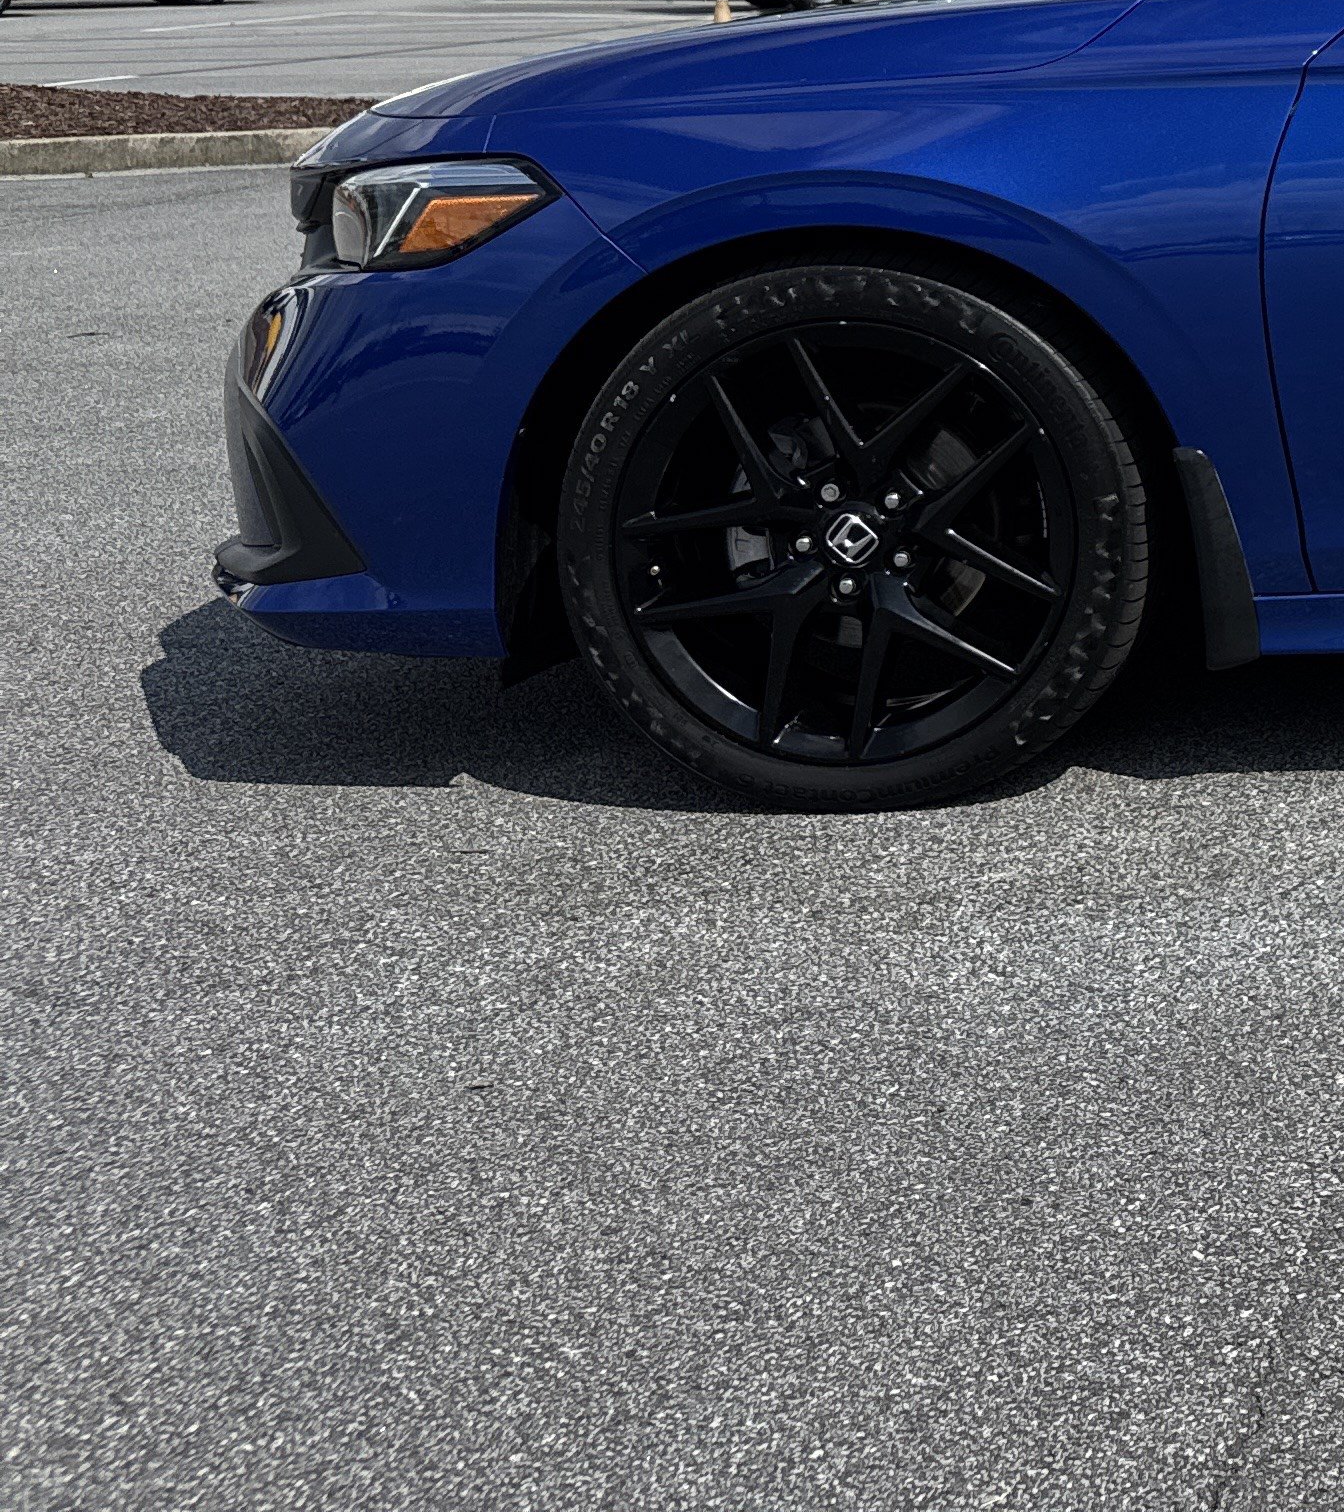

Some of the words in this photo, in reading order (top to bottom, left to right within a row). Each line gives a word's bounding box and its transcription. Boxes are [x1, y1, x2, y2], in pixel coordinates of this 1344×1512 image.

[569, 431, 608, 532] 245/40
[597, 406, 623, 434] R
[610, 375, 645, 414] 18
[636, 352, 665, 381] Y
